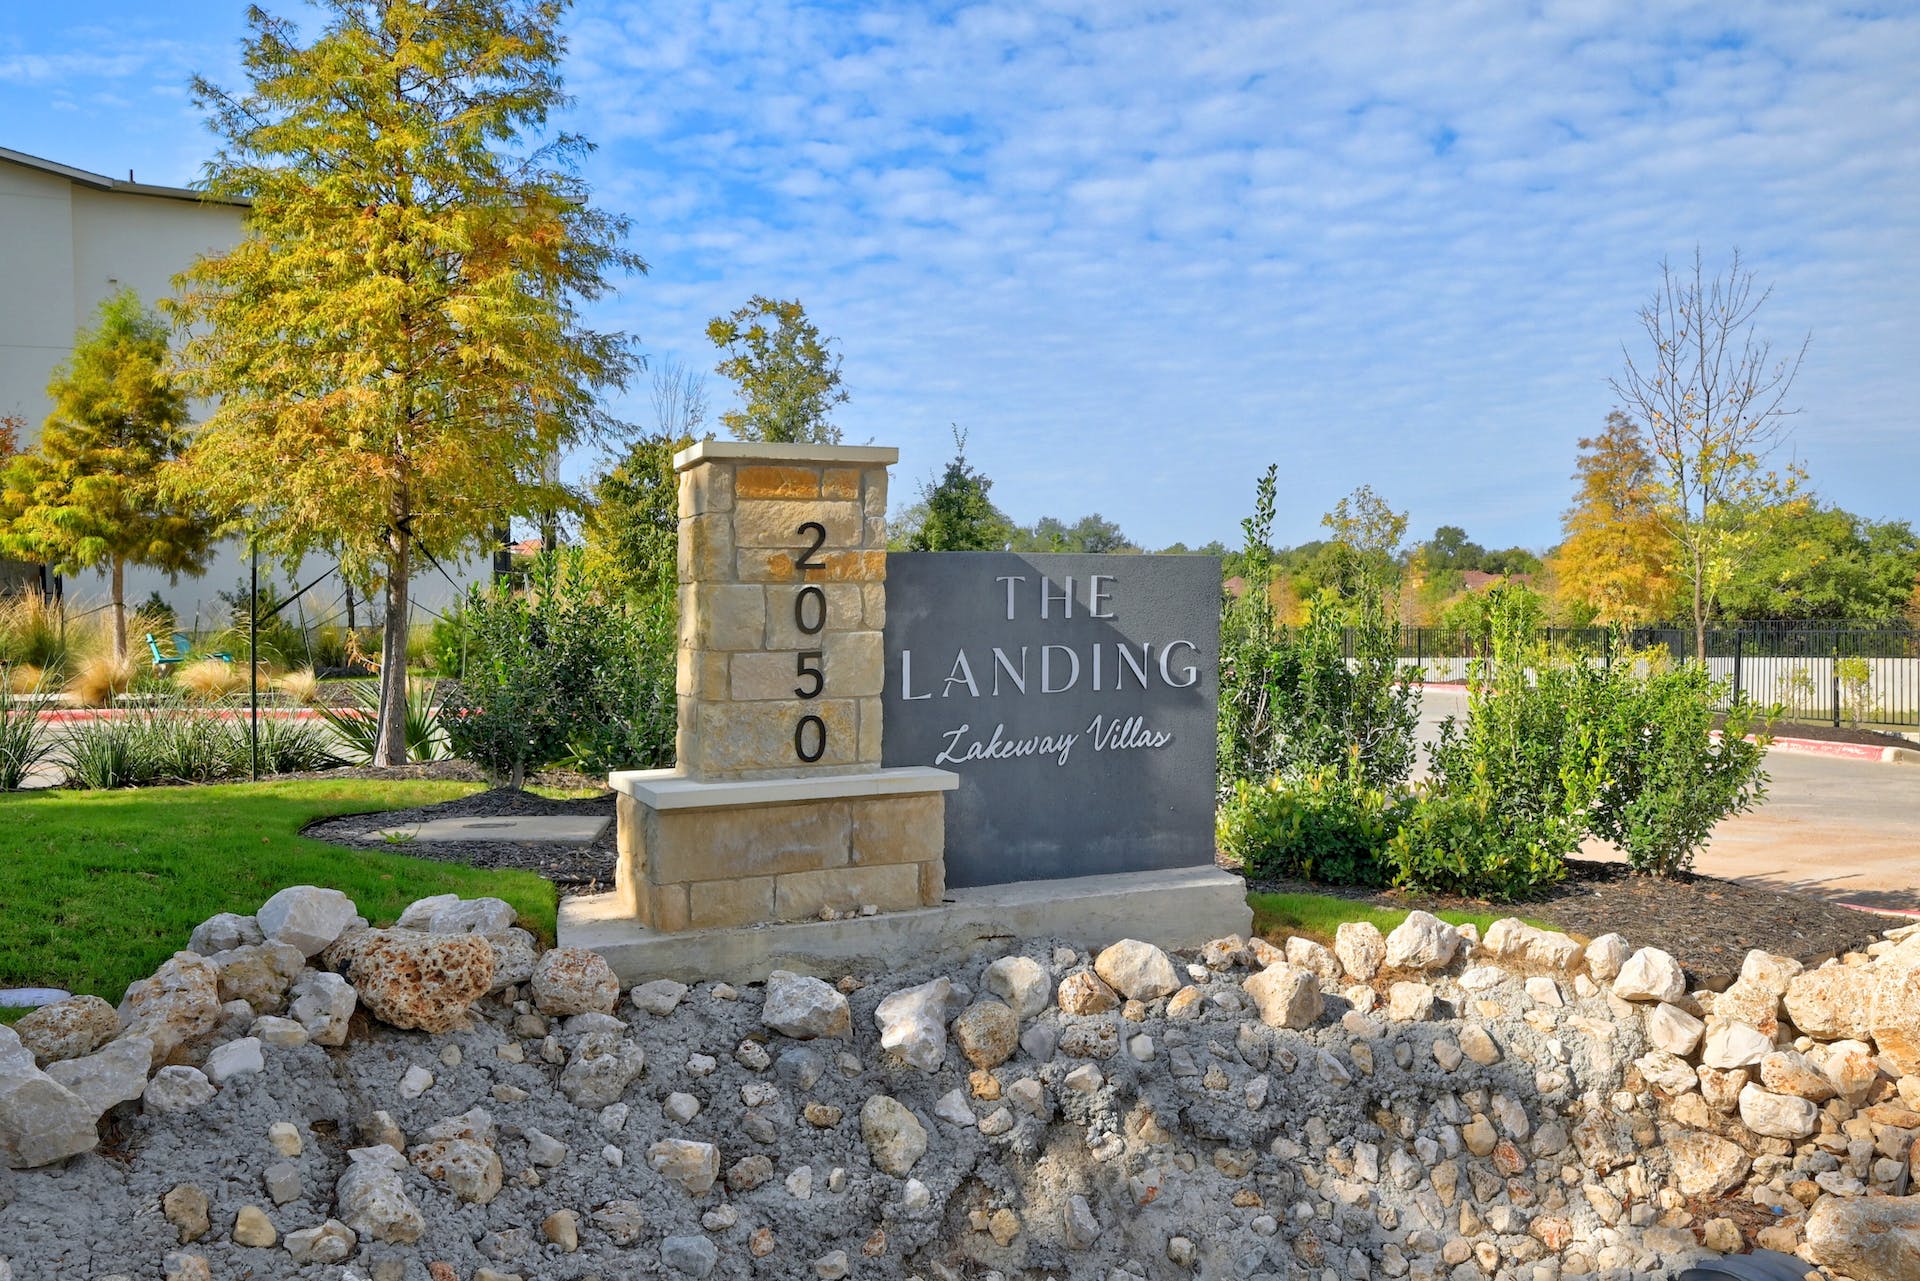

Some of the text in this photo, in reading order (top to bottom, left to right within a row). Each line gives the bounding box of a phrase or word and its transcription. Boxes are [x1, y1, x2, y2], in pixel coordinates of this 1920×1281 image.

[996, 575, 1114, 620] THE
[794, 521, 827, 763] 2050
[902, 640, 1198, 700] LANDING
[934, 714, 1171, 766] Lakeway Villas
